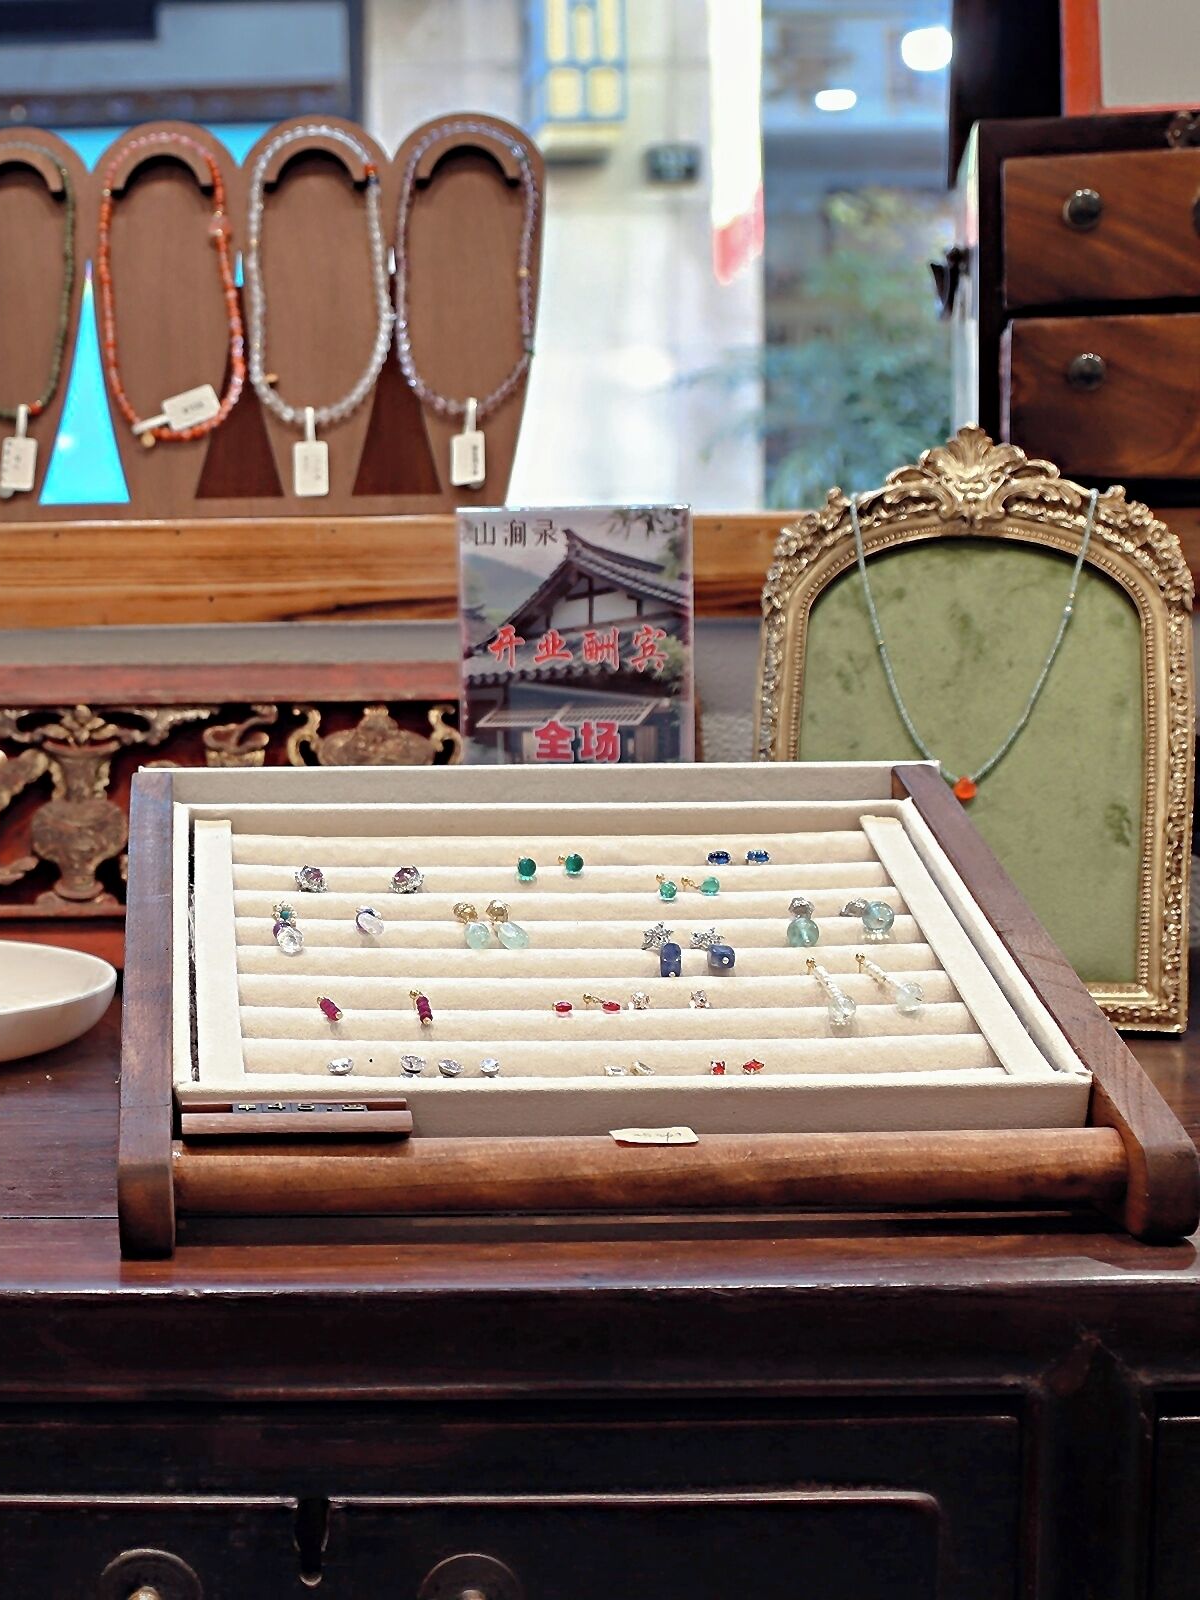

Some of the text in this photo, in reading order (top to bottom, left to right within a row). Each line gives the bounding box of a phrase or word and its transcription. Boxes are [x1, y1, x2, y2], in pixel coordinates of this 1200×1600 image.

[488, 624, 669, 672] 开业酬宾
[532, 720, 621, 762] 全场
